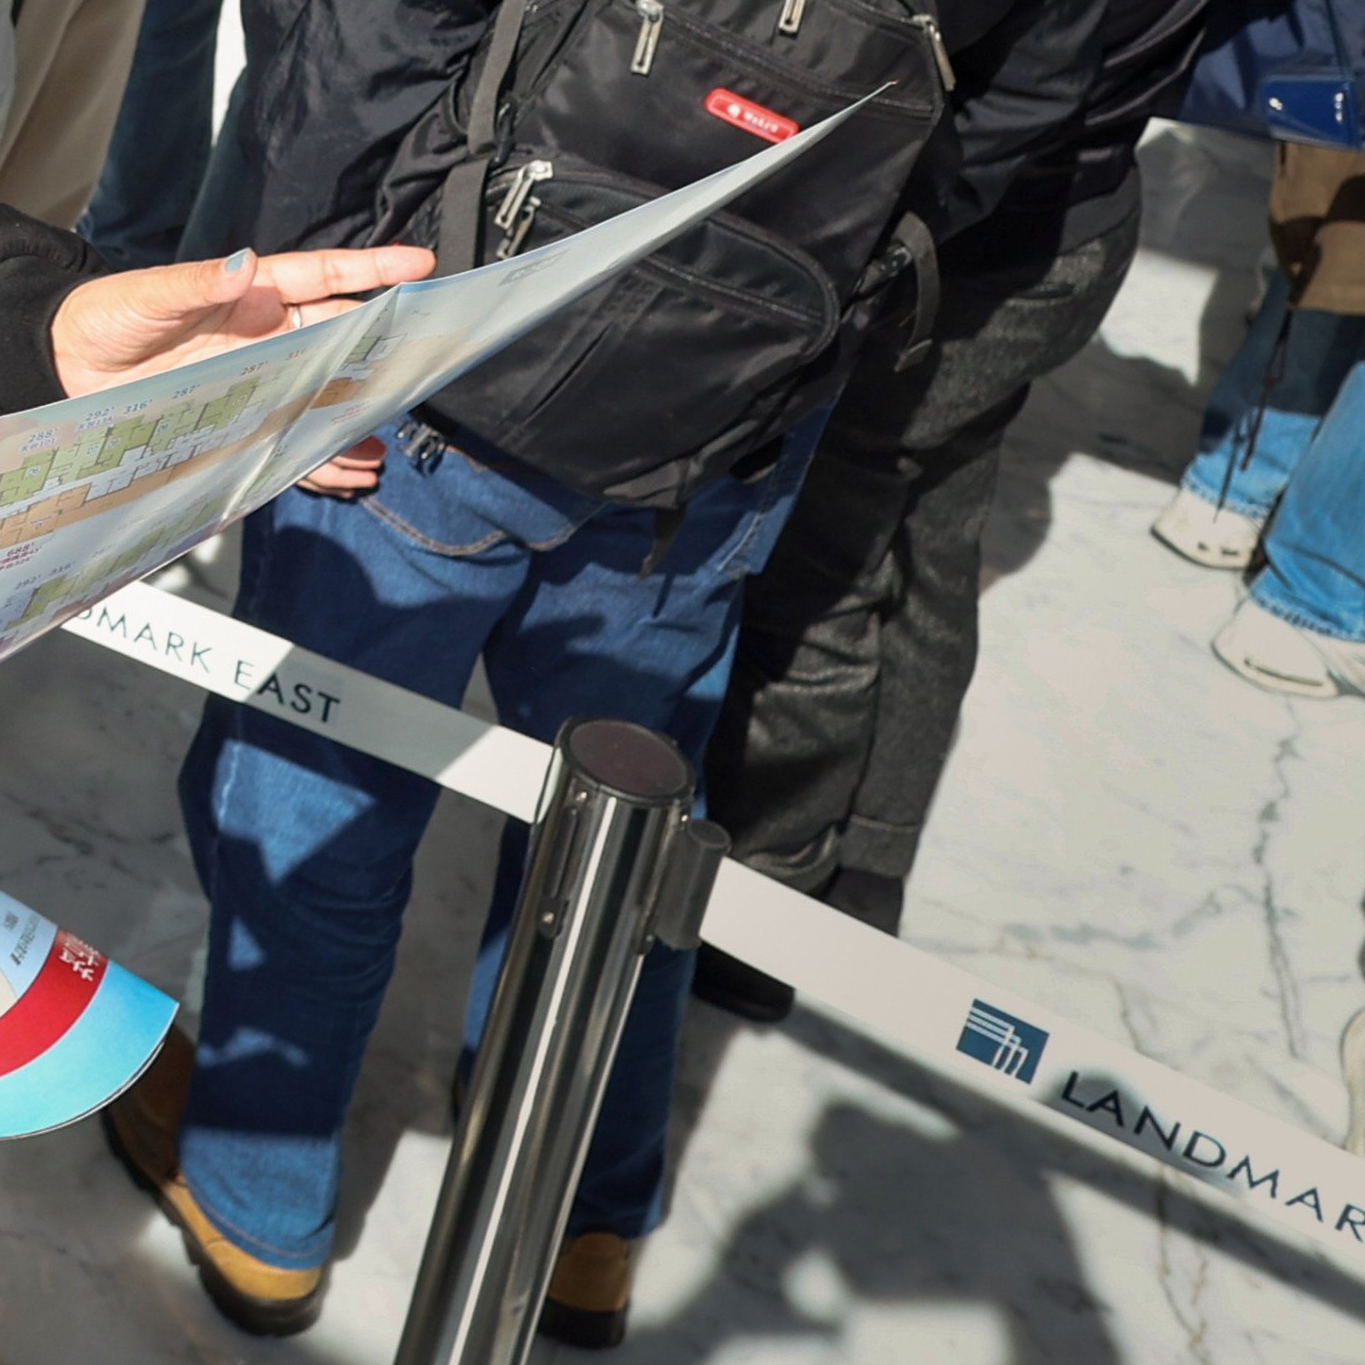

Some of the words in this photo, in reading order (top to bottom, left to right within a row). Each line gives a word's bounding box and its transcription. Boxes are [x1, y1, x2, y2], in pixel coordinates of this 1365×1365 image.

[85, 406, 115, 421] 292'
[28, 427, 58, 442] 288'
[234, 659, 341, 723] EAST
